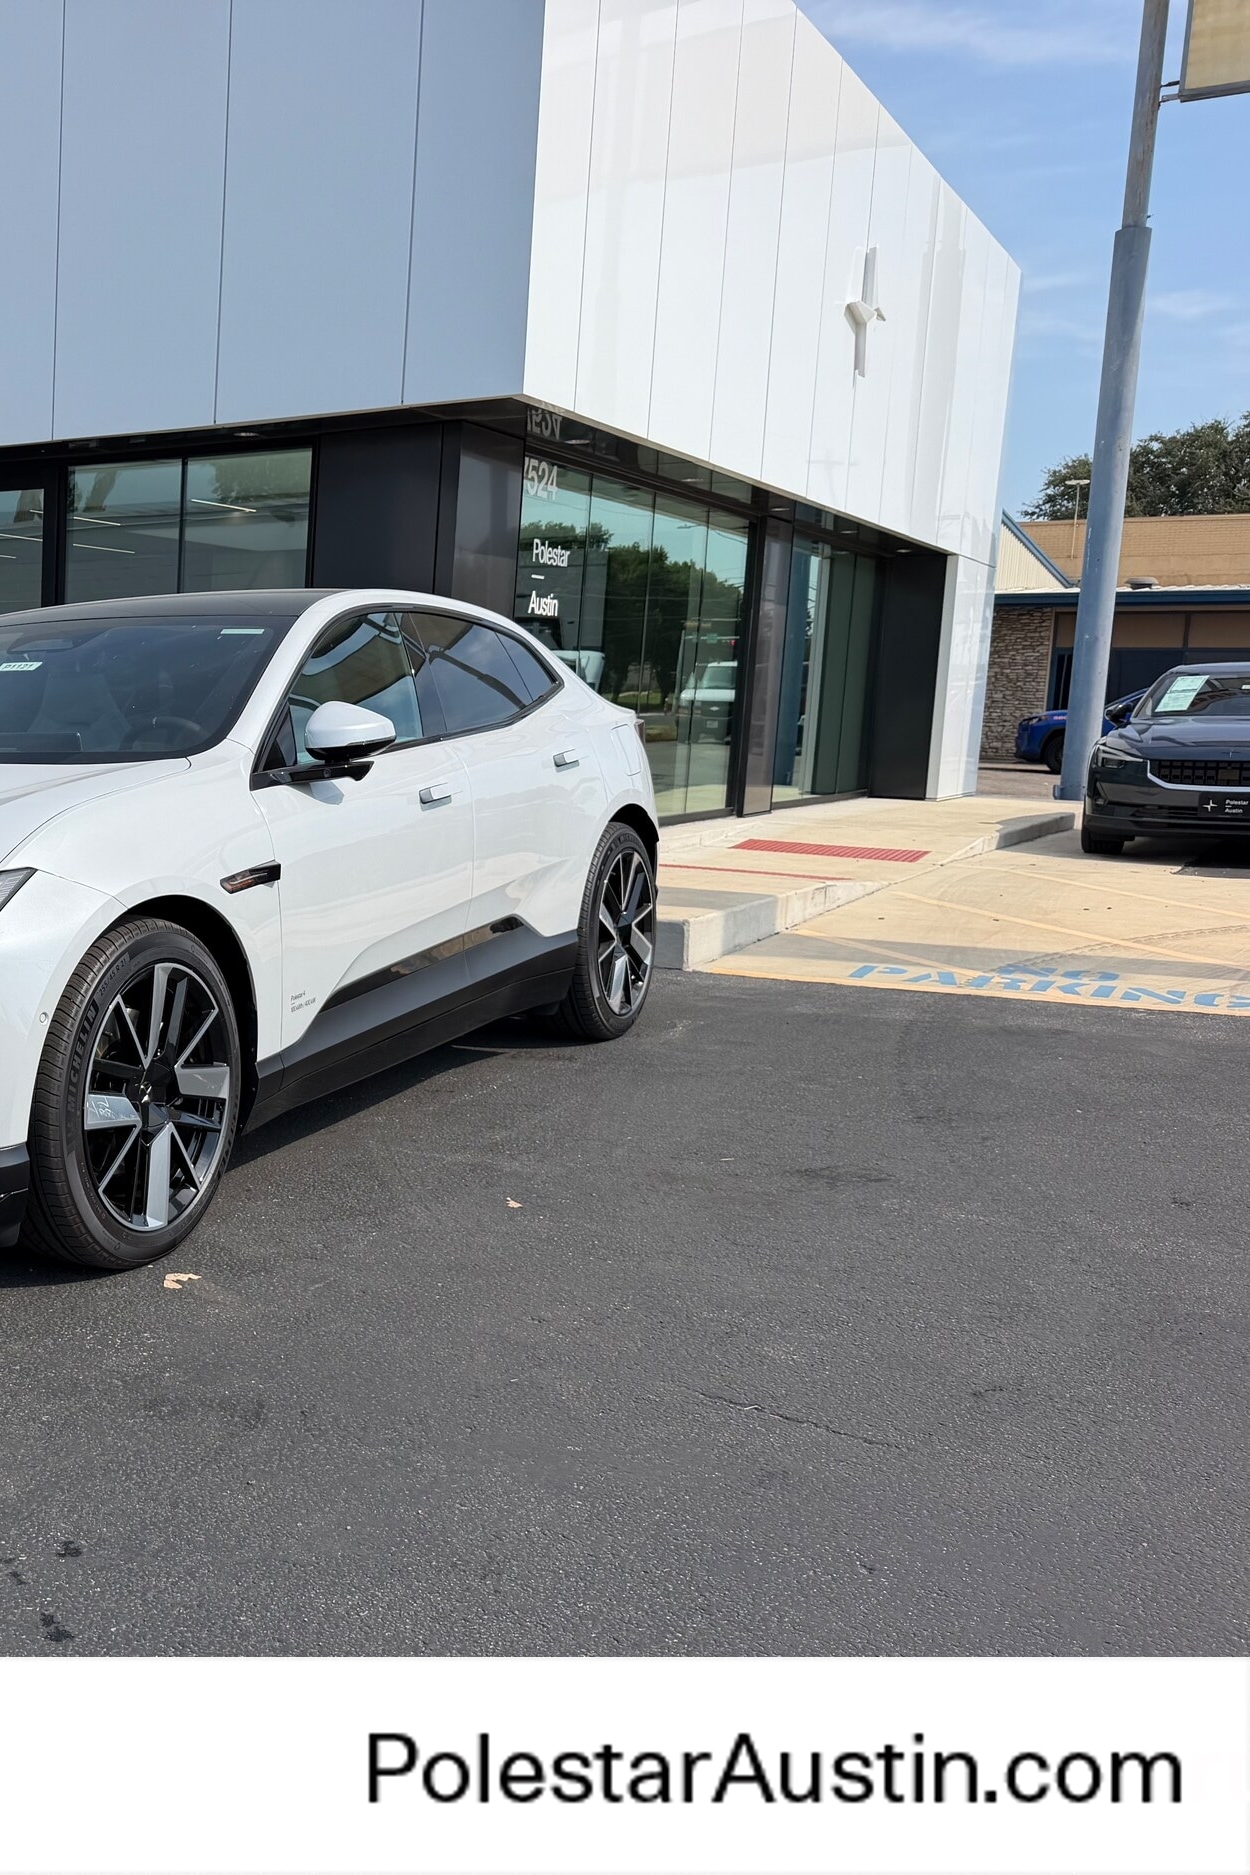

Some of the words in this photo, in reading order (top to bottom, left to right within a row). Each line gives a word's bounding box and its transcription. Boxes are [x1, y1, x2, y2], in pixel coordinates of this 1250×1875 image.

[532, 538, 570, 567] Polestar
[527, 590, 558, 616] Austin
[996, 963, 1121, 982] NO
[67, 1000, 98, 1112] MICHELIN
